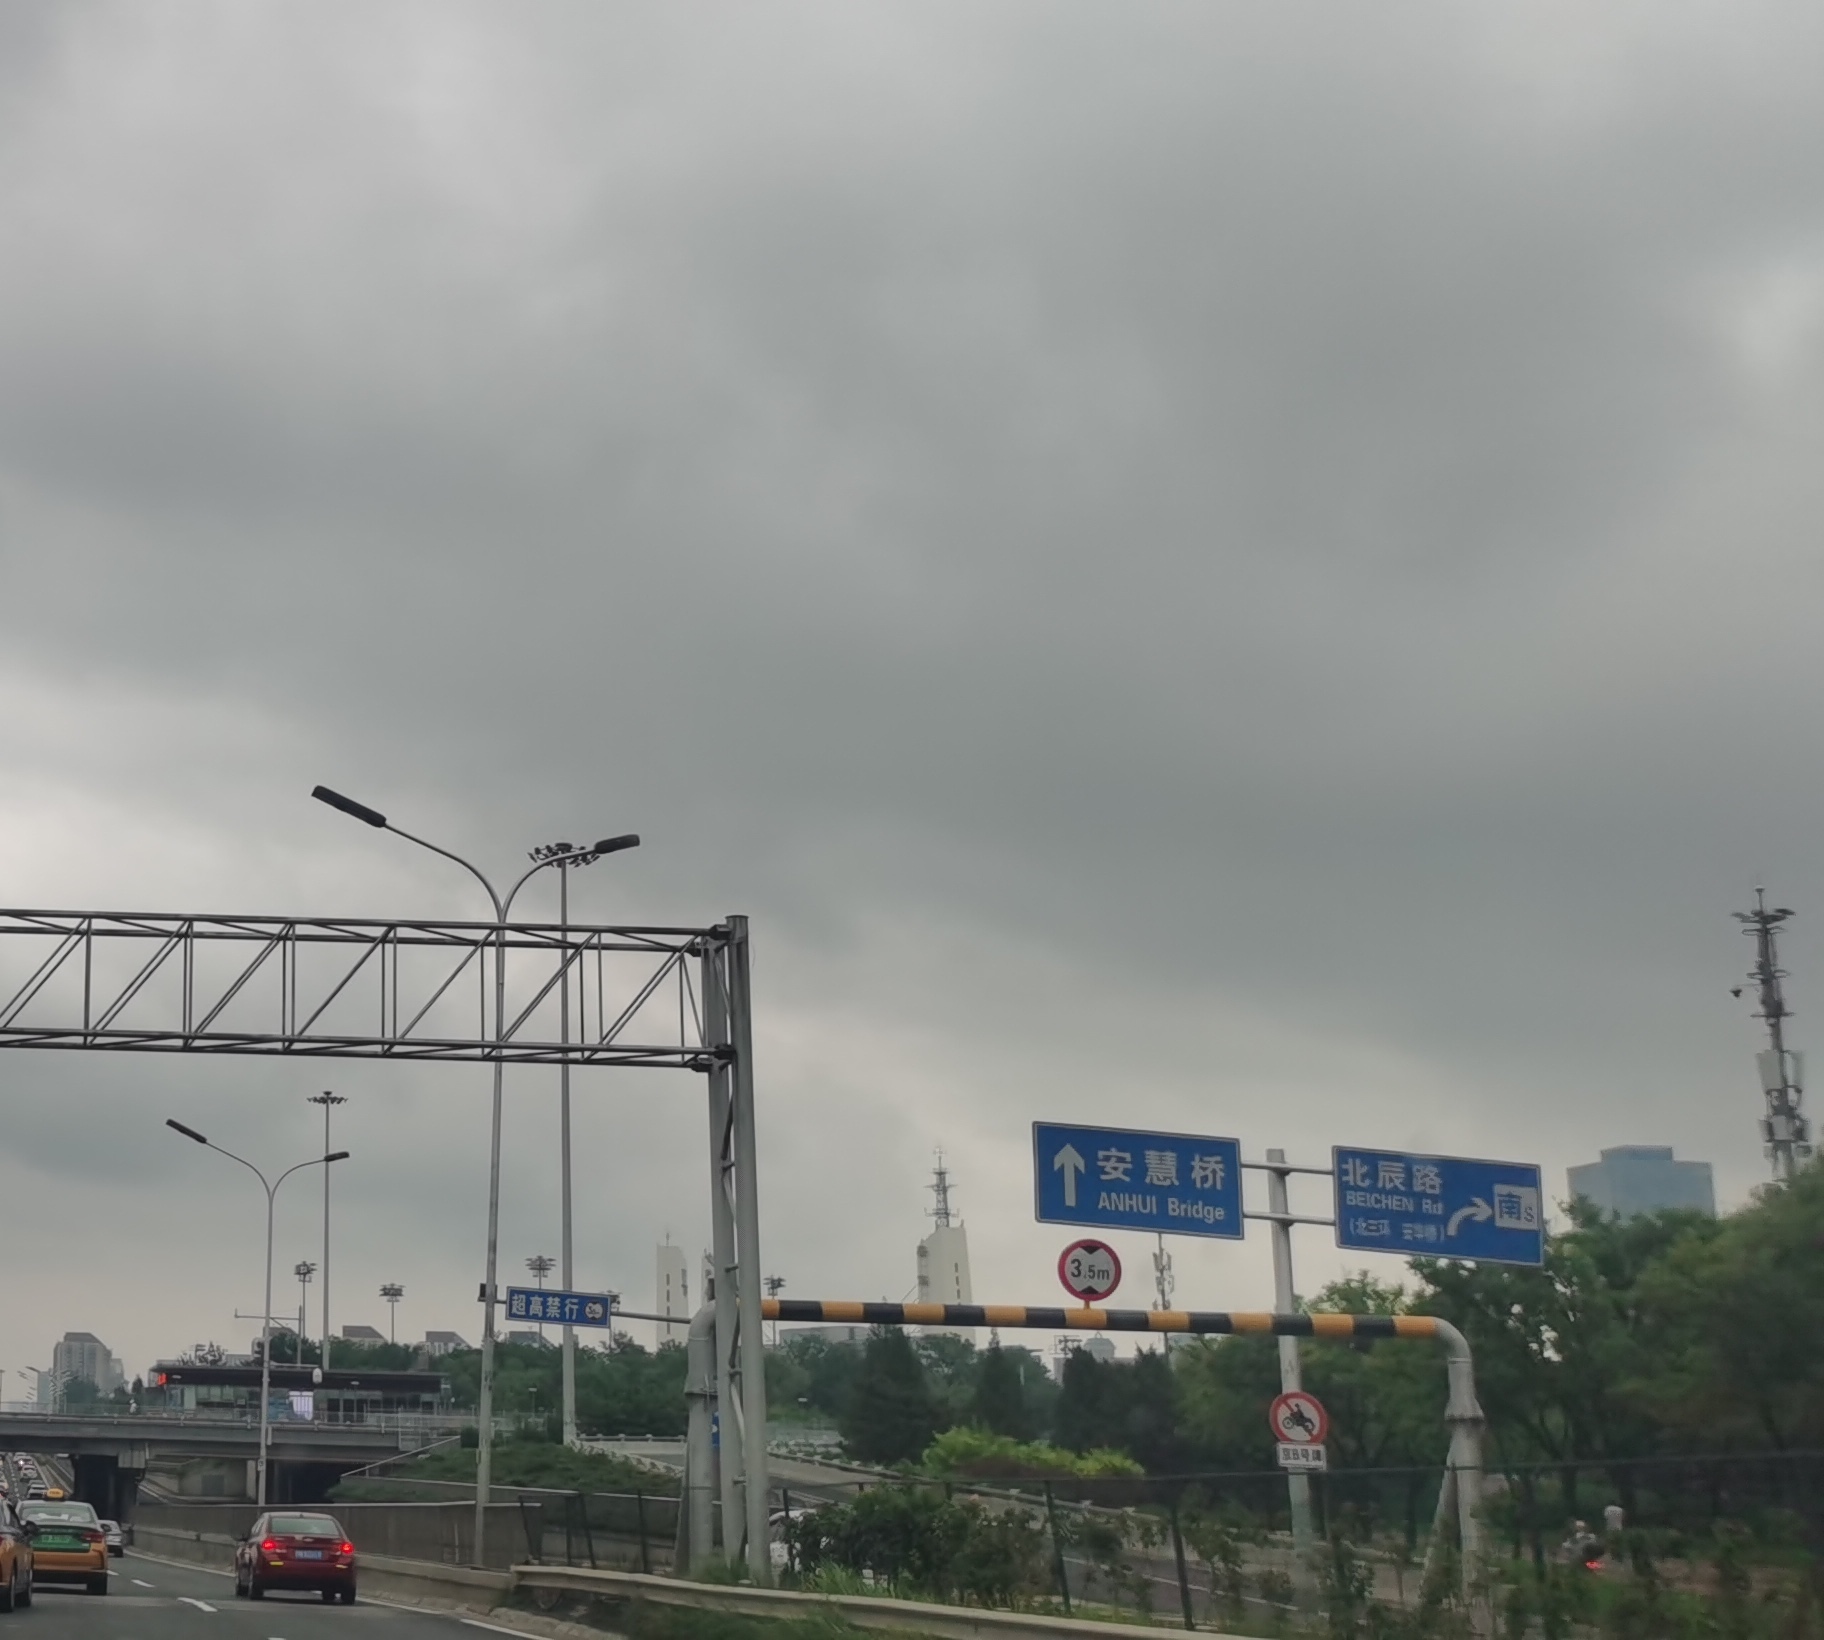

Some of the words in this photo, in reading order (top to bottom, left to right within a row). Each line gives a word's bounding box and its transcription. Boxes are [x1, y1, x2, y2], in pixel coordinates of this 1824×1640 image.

[1096, 1147, 1225, 1191] 安慧桥
[1341, 1157, 1443, 1195] 北辰路
[1098, 1191, 1157, 1215] ANHUI
[1168, 1197, 1225, 1224] Bridge
[1345, 1190, 1414, 1213] BEICHEN
[1422, 1198, 1443, 1215] Rd
[1497, 1191, 1522, 1221] 南
[1524, 1206, 1535, 1223] S
[1071, 1258, 1110, 1281] 3.5m
[511, 1293, 579, 1321] 超高禁行
